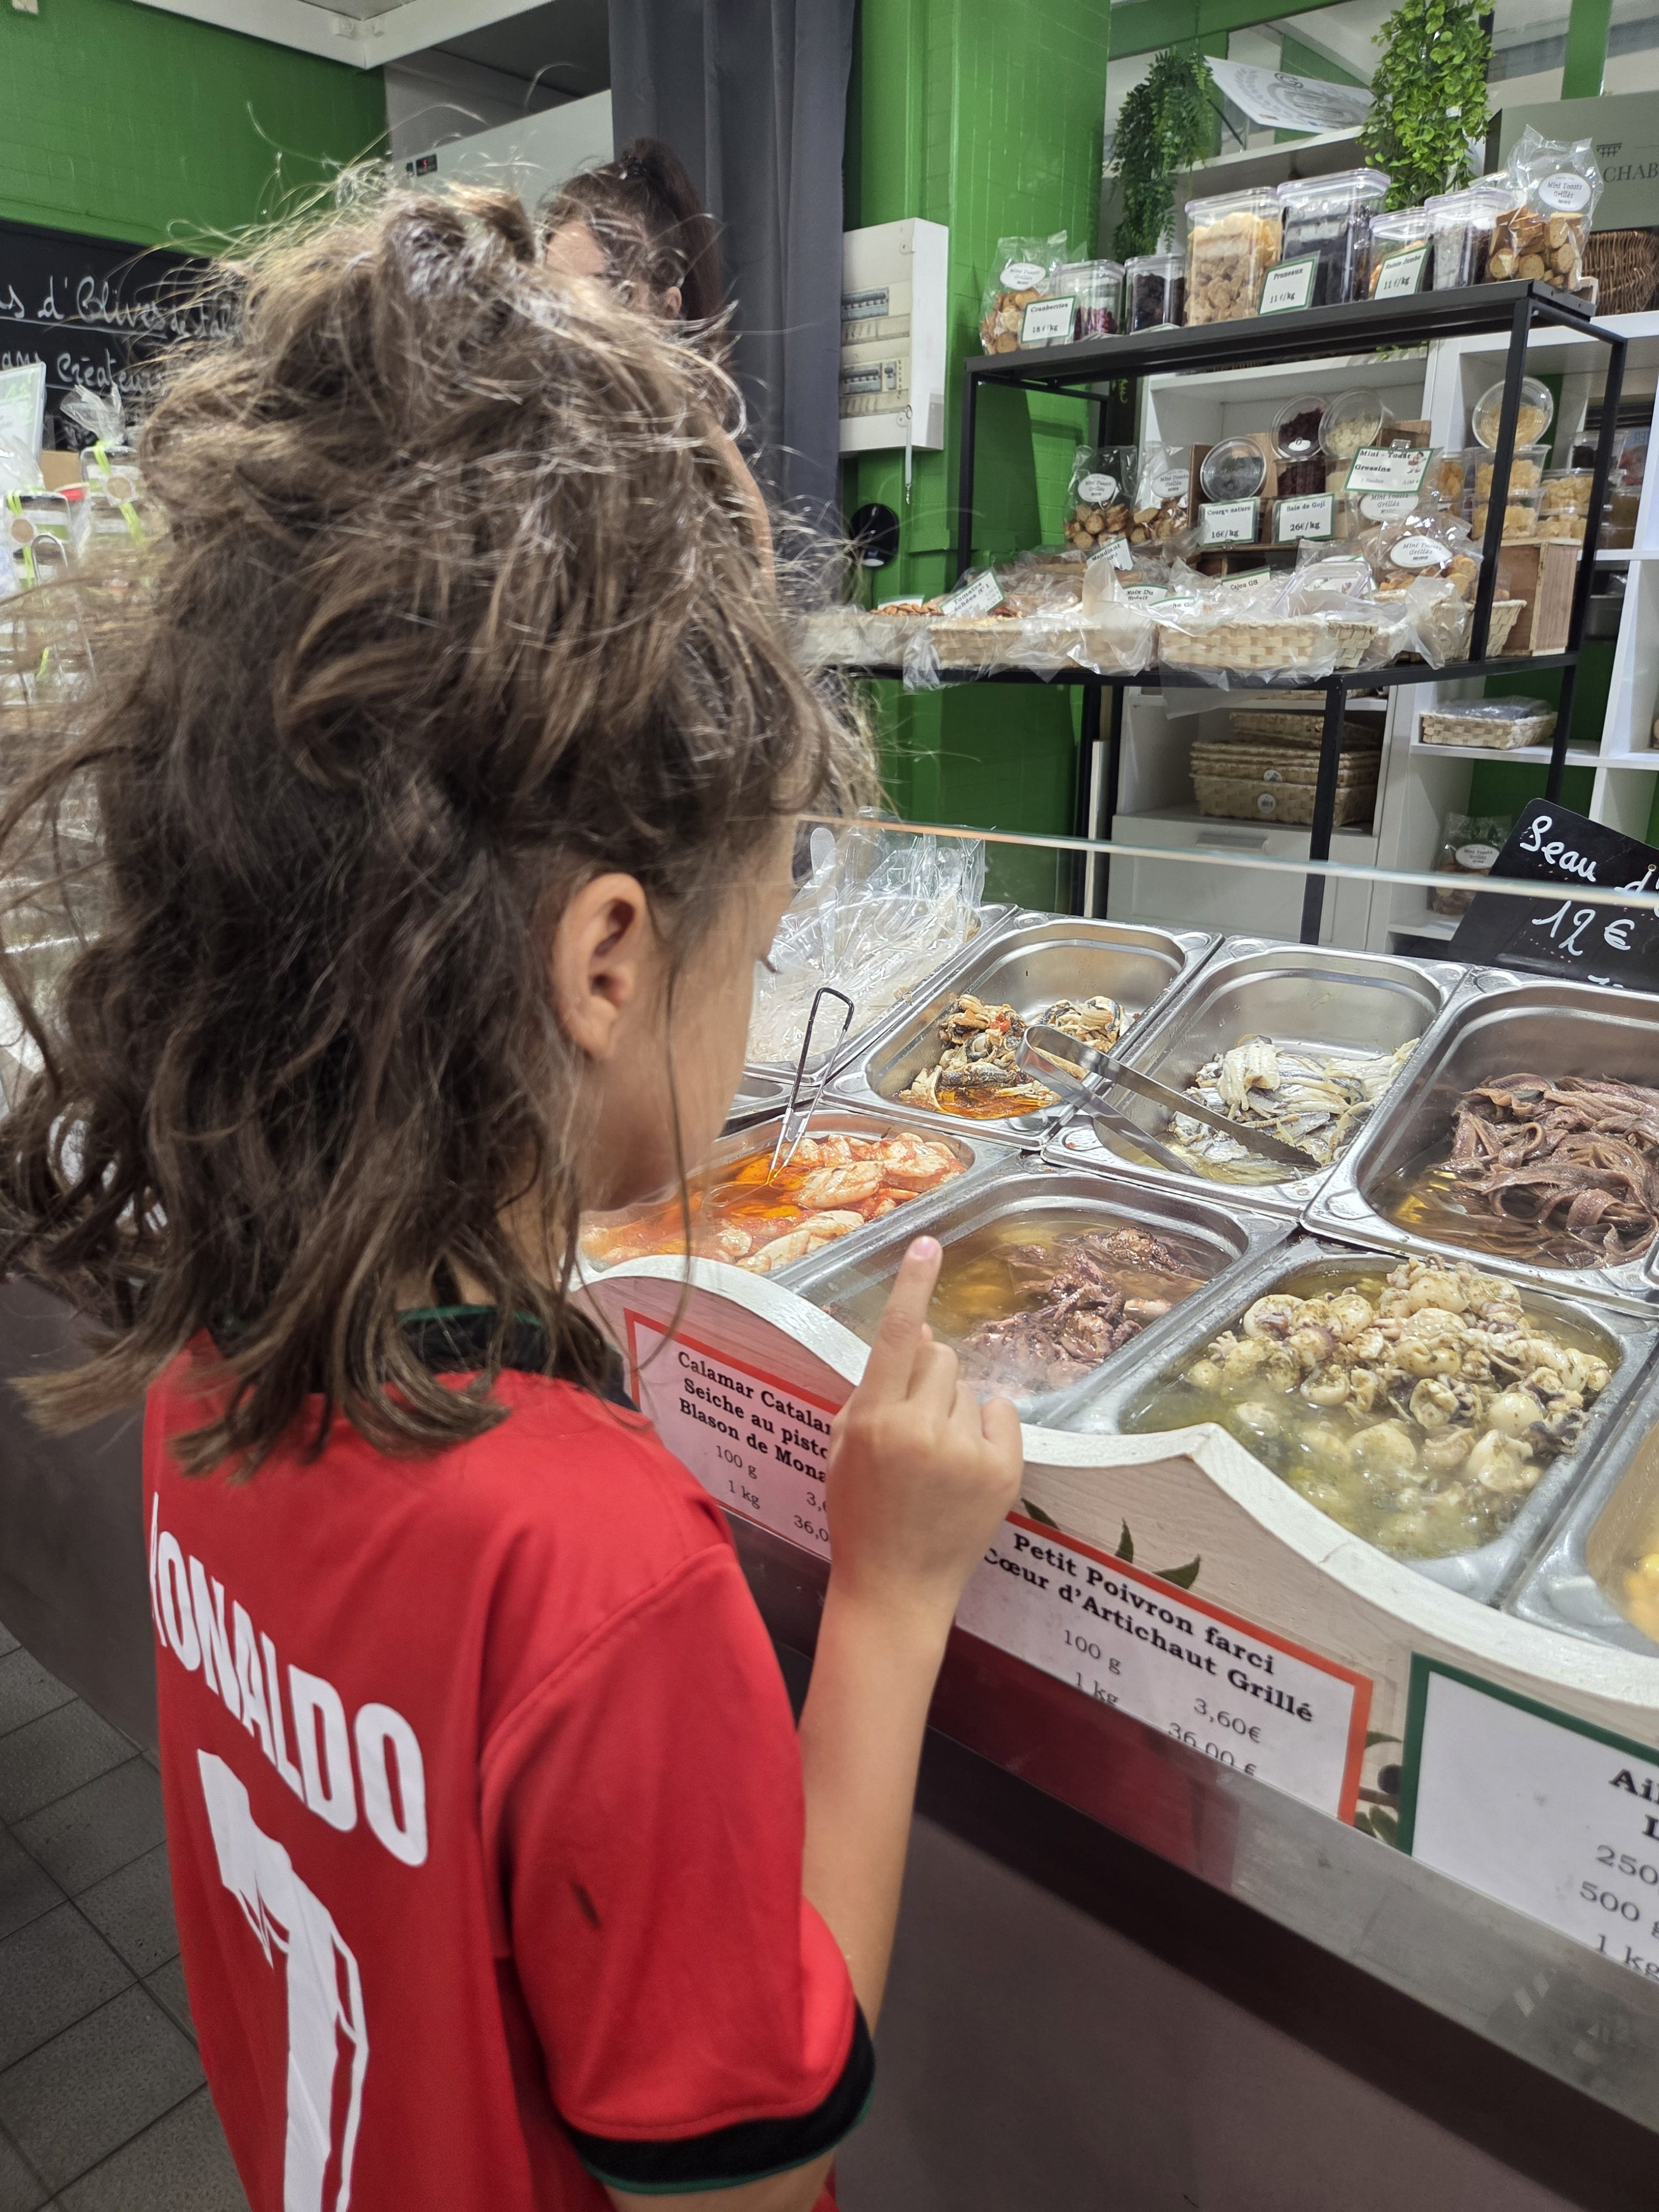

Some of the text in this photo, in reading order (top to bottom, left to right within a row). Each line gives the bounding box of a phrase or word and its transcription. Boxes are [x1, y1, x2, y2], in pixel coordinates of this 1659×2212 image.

[1274, 268, 1303, 280] Pruneaux
[1520, 816, 1597, 883] Seau
[1531, 900, 1635, 956] 12 €
[677, 1351, 754, 1400] Calamar
[679, 1397, 739, 1441] Blason
[746, 1433, 768, 1455] de
[684, 1378, 745, 1419] Seiche
[751, 1415, 775, 1434] au
[716, 1444, 827, 1513] 100 g 3,
[728, 1480, 736, 1494] 1
[741, 1485, 761, 1510] kg
[1013, 1532, 1276, 1675] Petit Poivron farci
[1058, 1584, 1218, 1676] d'Artichaut
[1227, 1668, 1314, 1723] Grillé
[1063, 1629, 1262, 1744] 100 g 3,60€
[1076, 1671, 1083, 1687] 1
[1092, 1679, 1119, 1705] kg
[1168, 1722, 1235, 1767] 3600
[1596, 1844, 1659, 1886] 250
[1579, 1880, 1640, 1923] 500
[1598, 1933, 1608, 1954] 1
